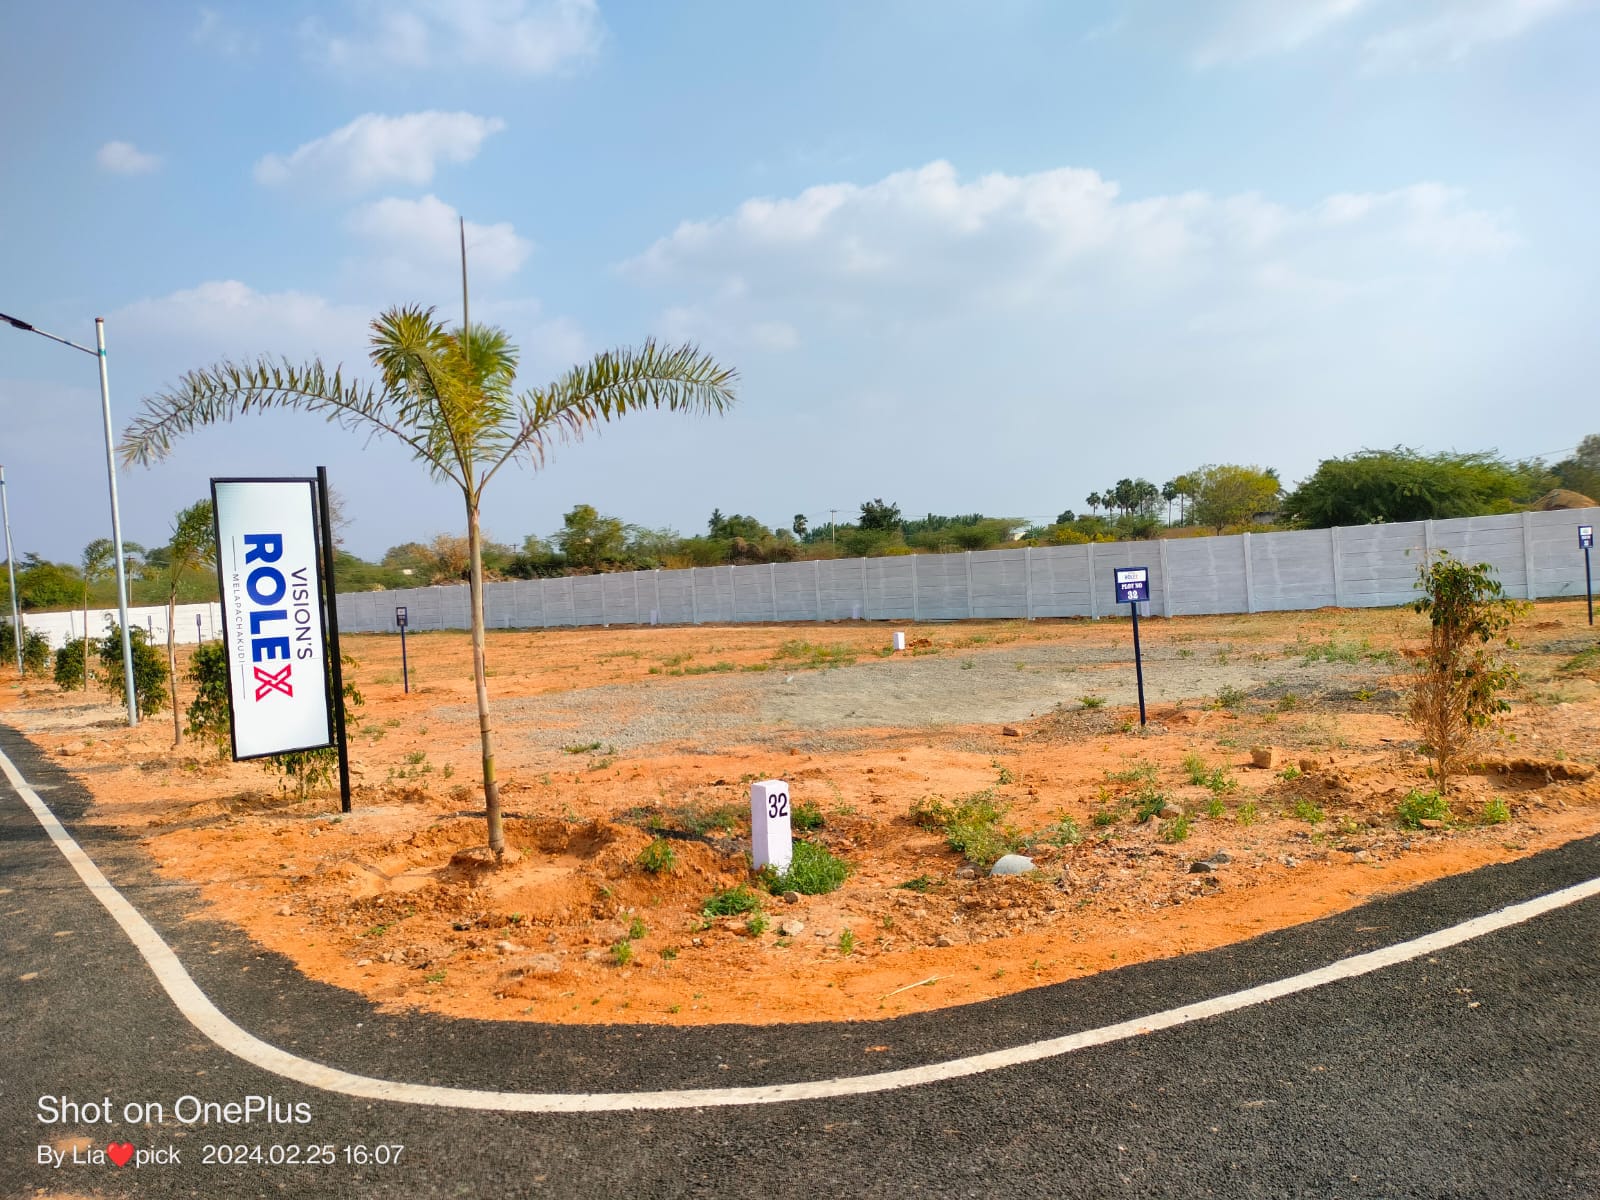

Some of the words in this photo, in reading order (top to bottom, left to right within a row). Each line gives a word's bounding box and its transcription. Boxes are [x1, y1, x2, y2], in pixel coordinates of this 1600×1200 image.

[232, 573, 246, 663] MELAPACHAKUDI
[243, 533, 294, 702] ROLEX
[291, 567, 313, 660] VISION'S
[1127, 590, 1138, 600] 32
[768, 792, 788, 819] 32
